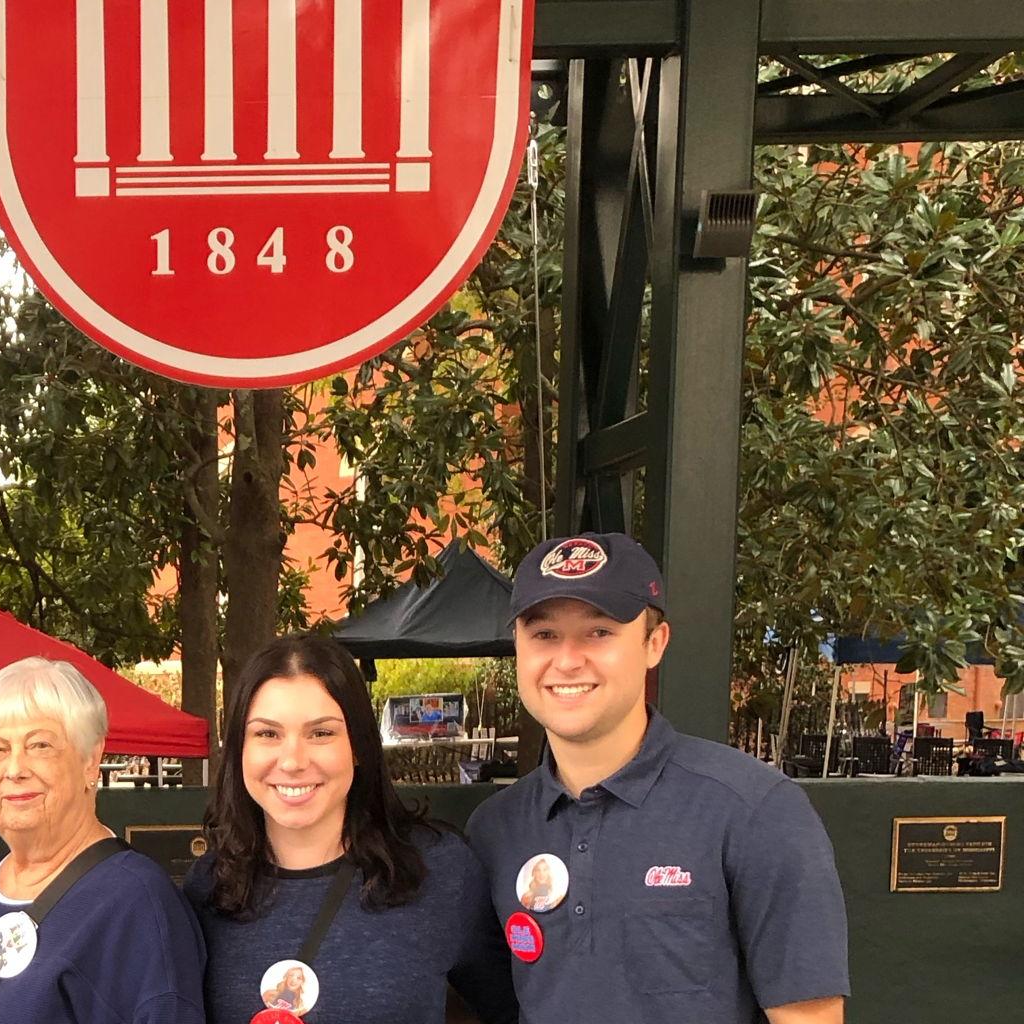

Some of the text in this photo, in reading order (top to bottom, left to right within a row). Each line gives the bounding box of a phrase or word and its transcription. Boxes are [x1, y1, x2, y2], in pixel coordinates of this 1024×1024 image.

[150, 225, 355, 276] 1848
[541, 545, 605, 572] Ole Miss
